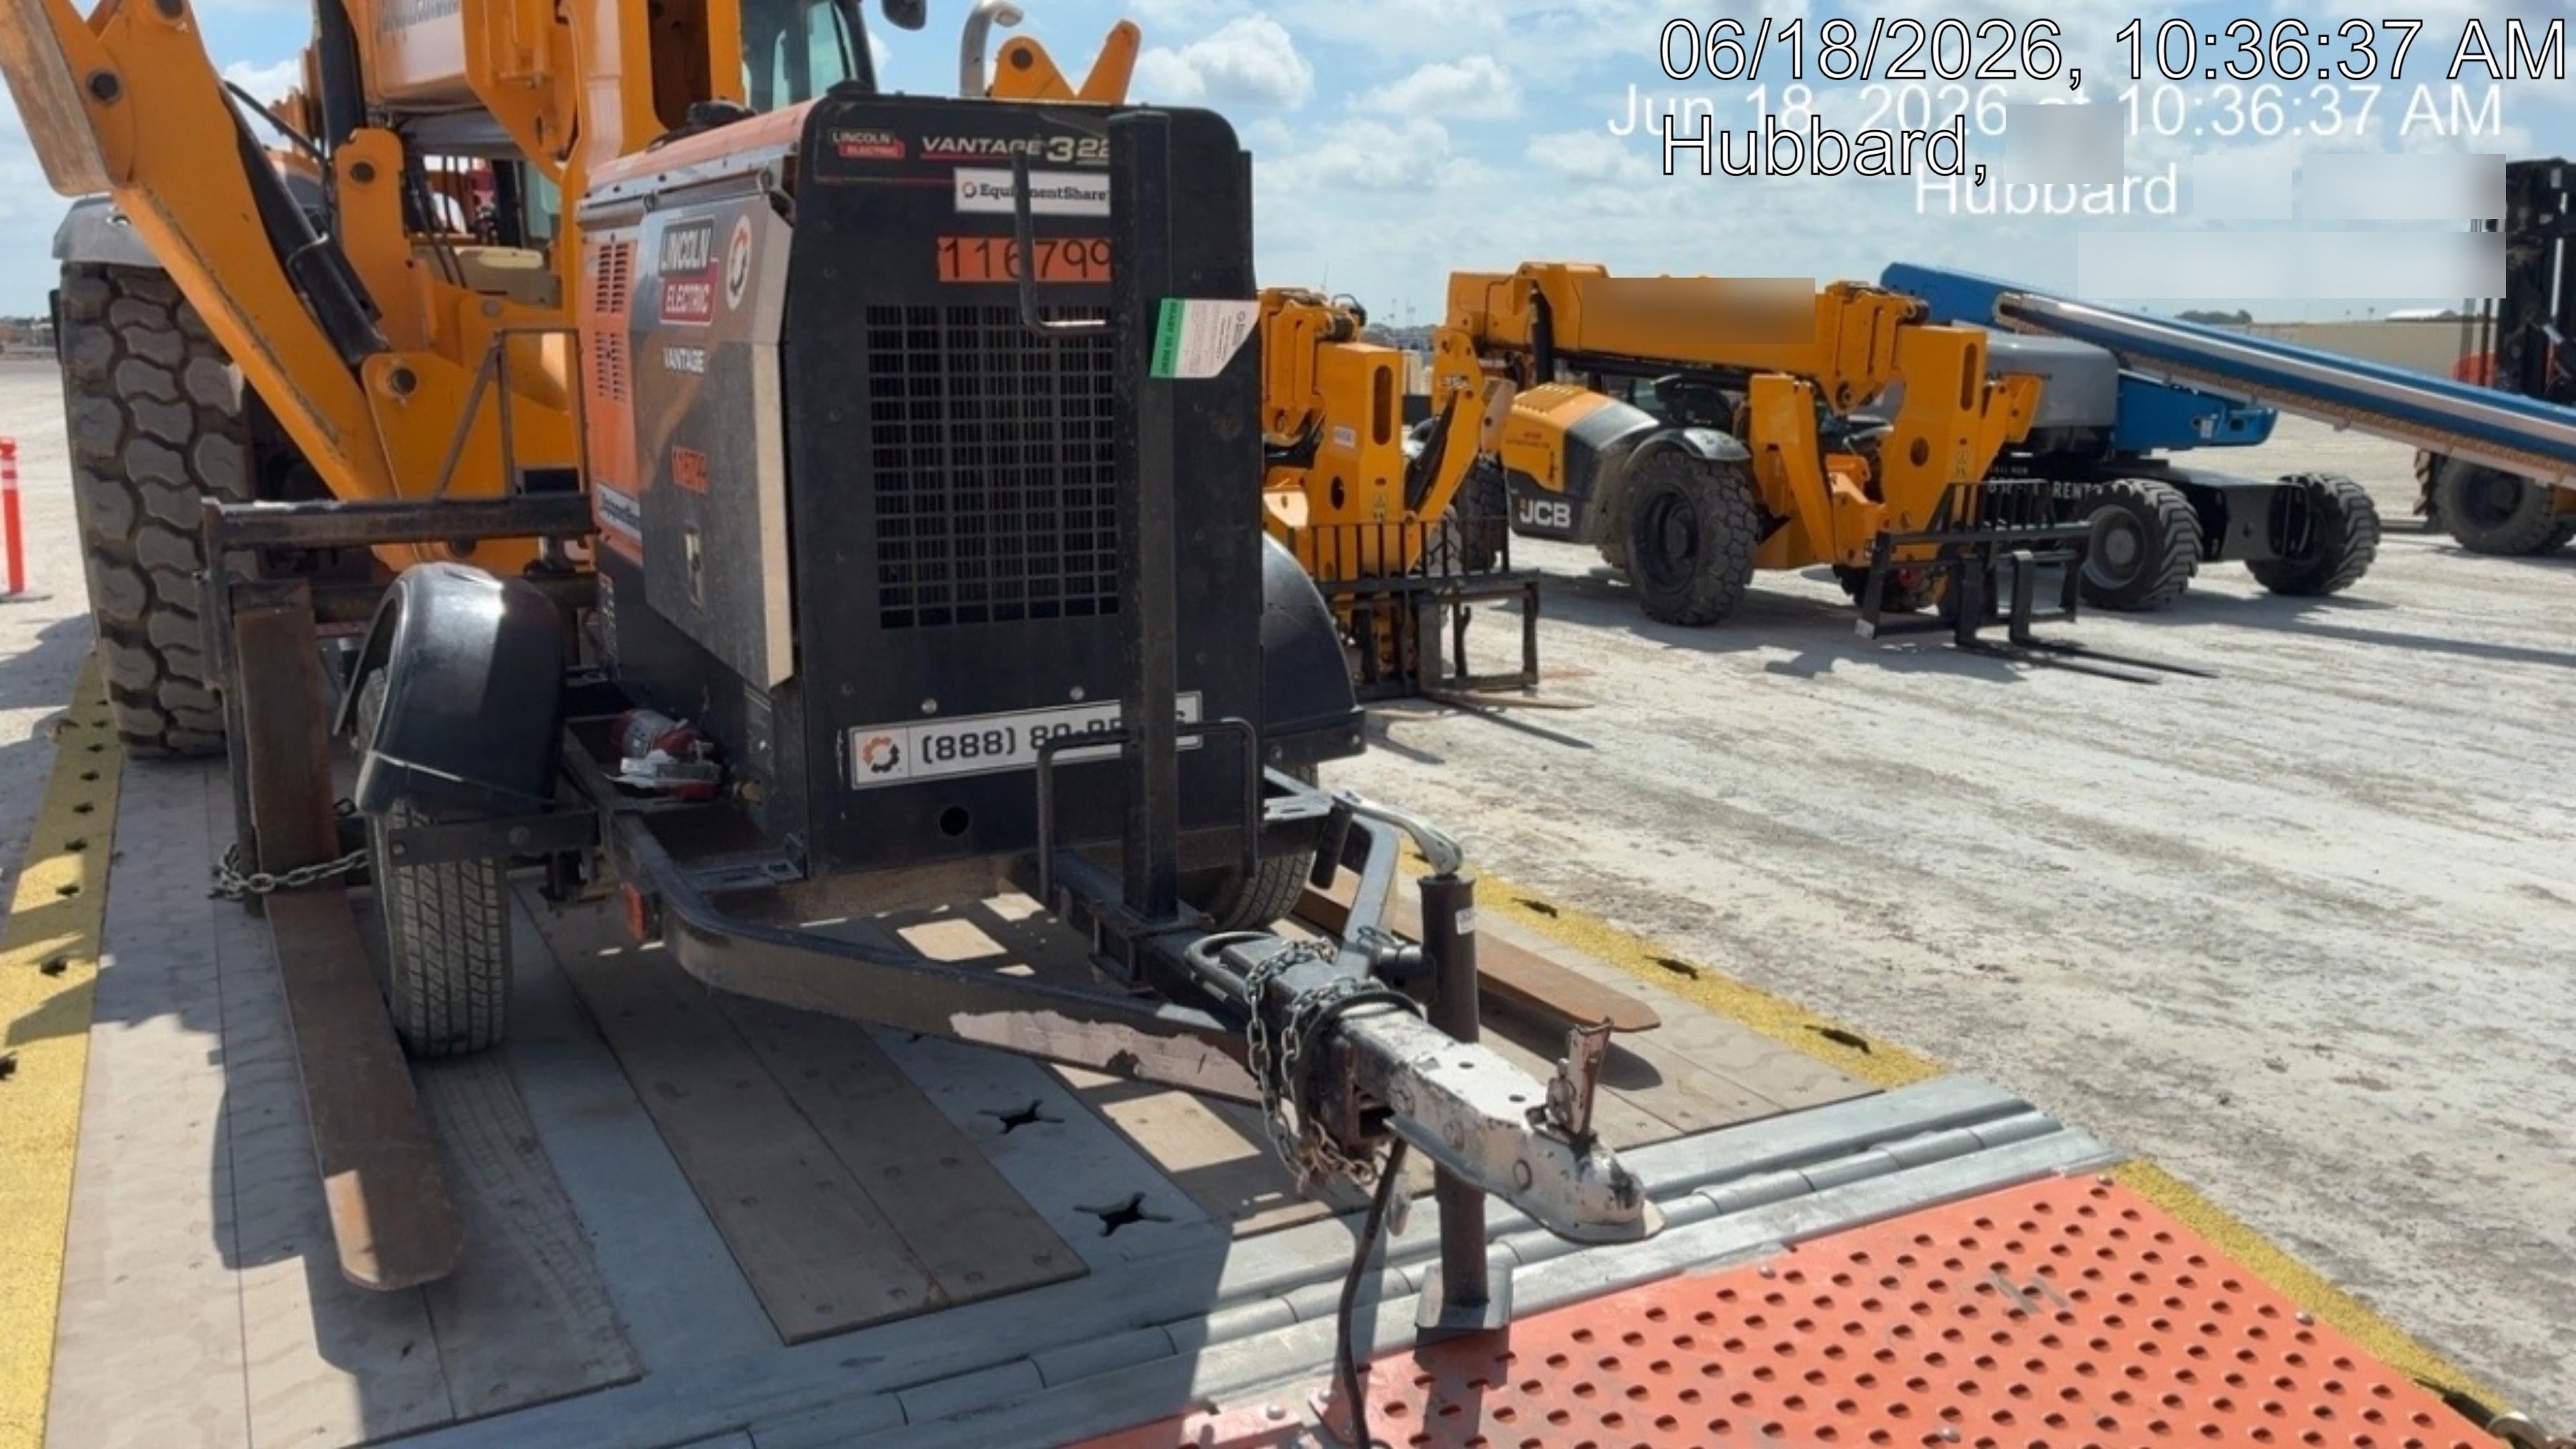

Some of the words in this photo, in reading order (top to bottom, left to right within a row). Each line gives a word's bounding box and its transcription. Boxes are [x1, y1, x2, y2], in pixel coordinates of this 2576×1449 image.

[831, 131, 891, 144] LINCOLN
[980, 183, 1108, 202] EquimentShare
[660, 226, 711, 271] LINCOLN
[944, 239, 1110, 278] 116799
[664, 283, 711, 315] ELECTRIC
[663, 346, 706, 374] VANTAGE
[1519, 498, 1571, 527] JCB
[922, 726, 1015, 764] (888)
